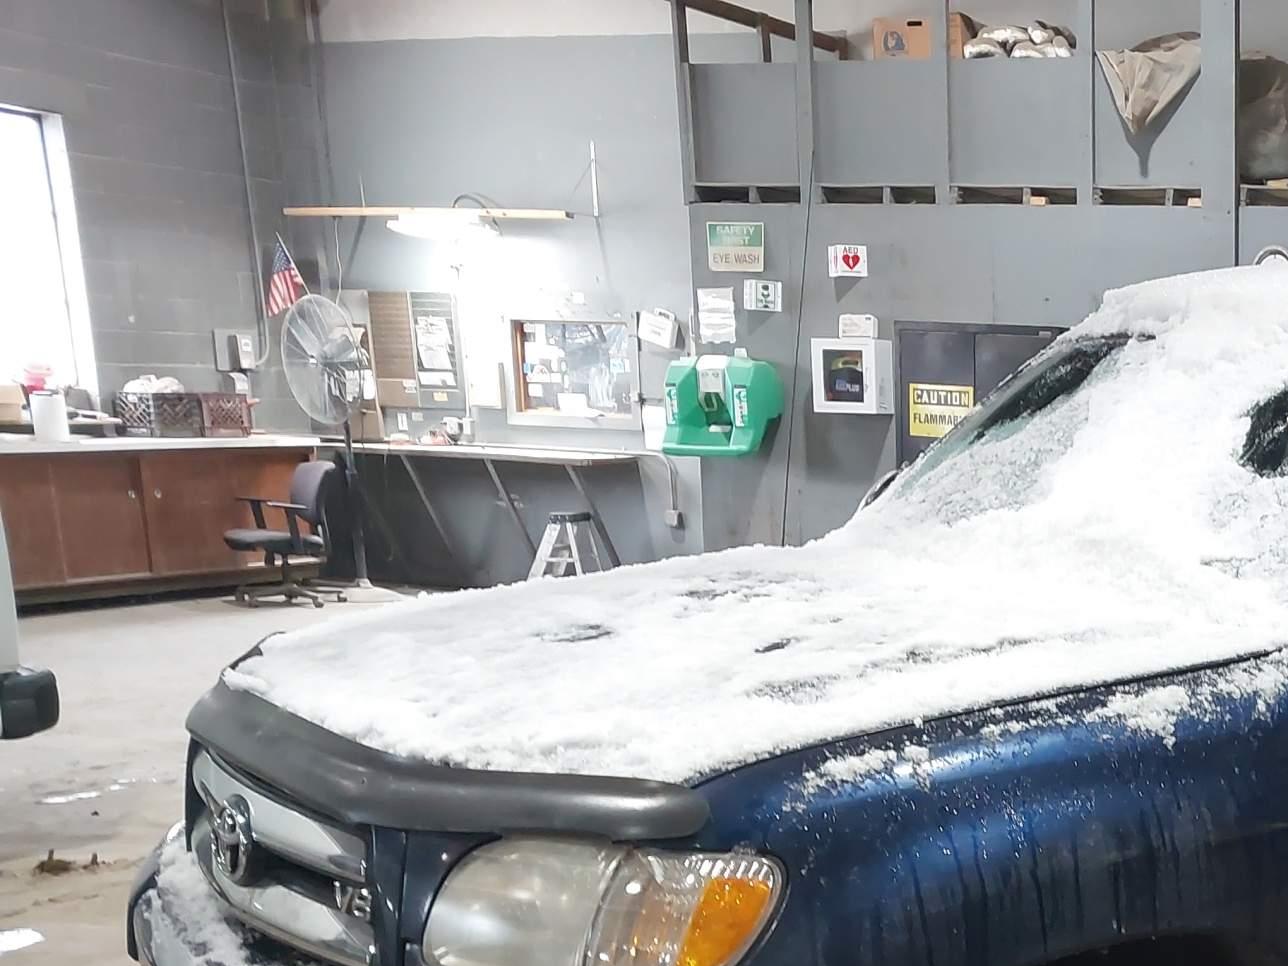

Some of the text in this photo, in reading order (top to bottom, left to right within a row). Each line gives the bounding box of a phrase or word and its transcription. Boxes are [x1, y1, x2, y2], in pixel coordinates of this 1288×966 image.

[716, 225, 755, 236] SAFETY
[842, 245, 859, 255] AED
[712, 252, 761, 265] EYE WASH
[914, 390, 970, 406] CAUTION
[913, 413, 963, 426] FLAMMAB
